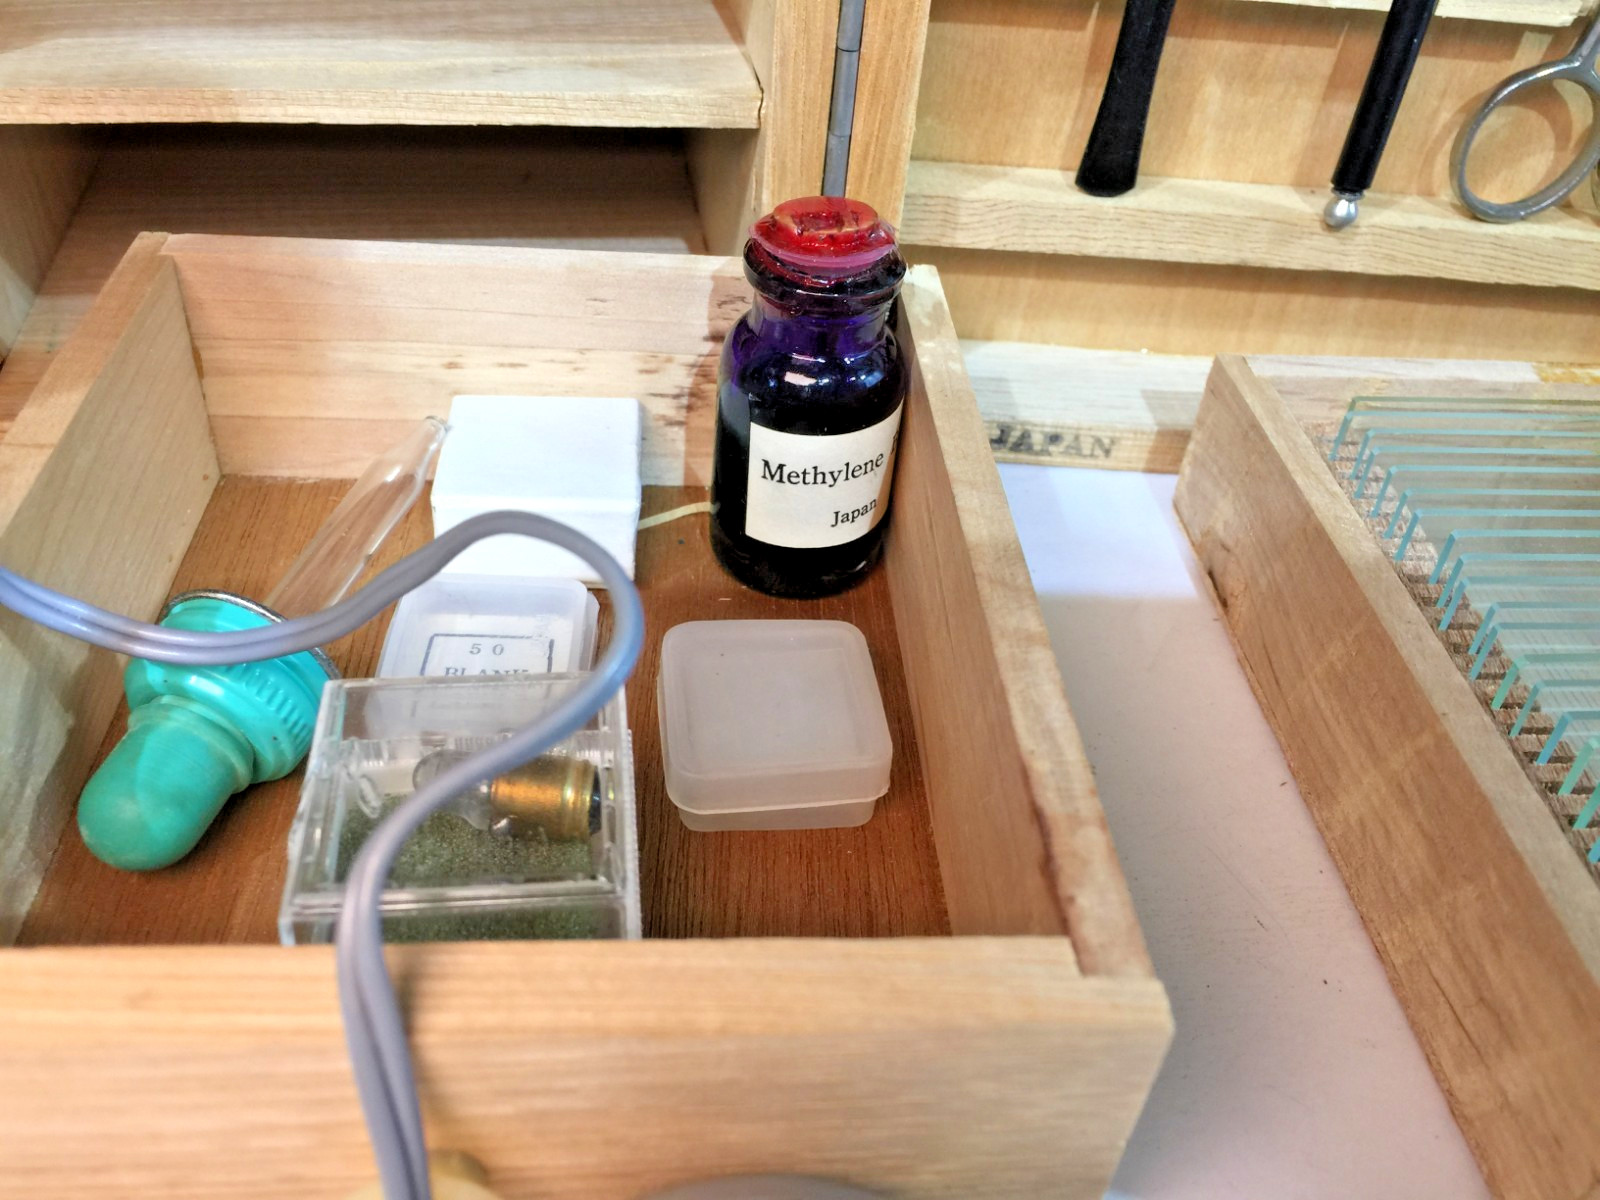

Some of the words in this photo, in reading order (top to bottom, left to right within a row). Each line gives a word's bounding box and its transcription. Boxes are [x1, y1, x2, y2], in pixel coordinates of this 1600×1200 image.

[989, 423, 1115, 458] JAPAN
[761, 453, 884, 487] Methylene
[830, 499, 877, 527] Japan
